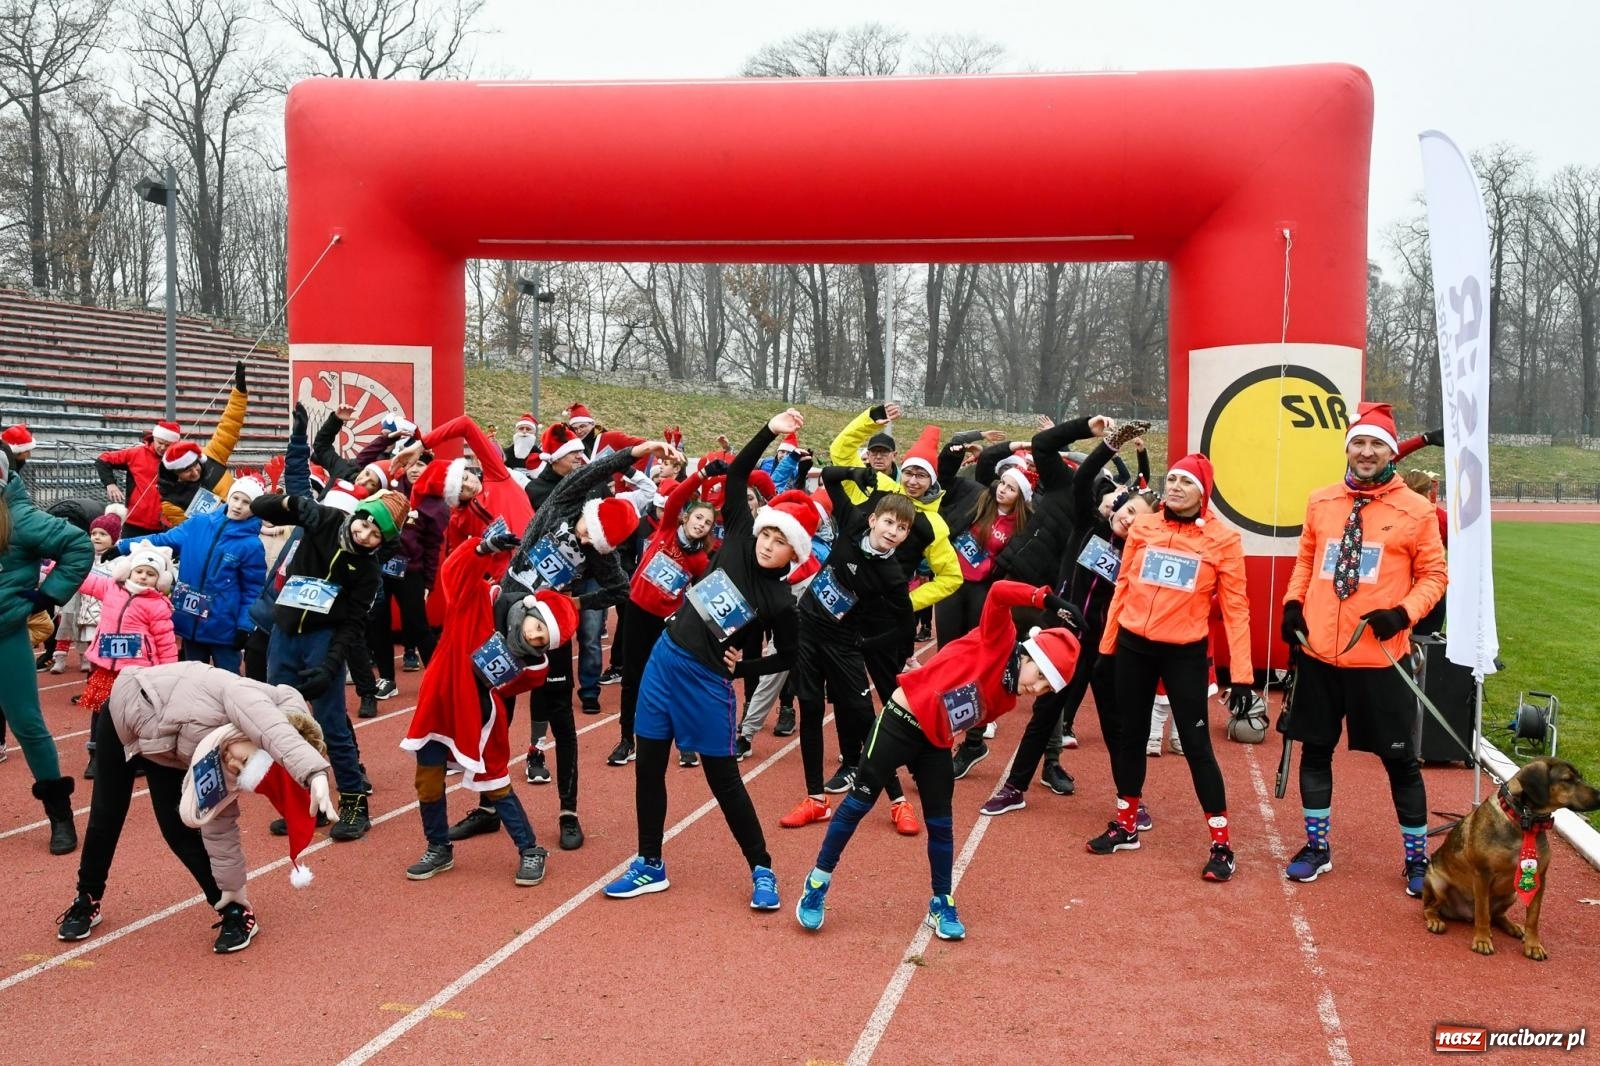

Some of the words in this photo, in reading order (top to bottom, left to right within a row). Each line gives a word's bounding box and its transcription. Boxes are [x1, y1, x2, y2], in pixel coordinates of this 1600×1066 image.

[200, 502, 211, 513] 75
[963, 544, 976, 557] 45
[540, 557, 560, 574] 57
[1096, 557, 1115, 573] 24
[1164, 565, 1174, 578] 9
[658, 569, 674, 584] 72
[299, 588, 318, 600] 40
[822, 590, 836, 605] 43
[185, 597, 197, 610] 10
[710, 595, 731, 618] 23
[112, 643, 126, 653] 11
[486, 658, 505, 678] 52
[955, 708, 969, 720] 5
[200, 773, 213, 797] 13
